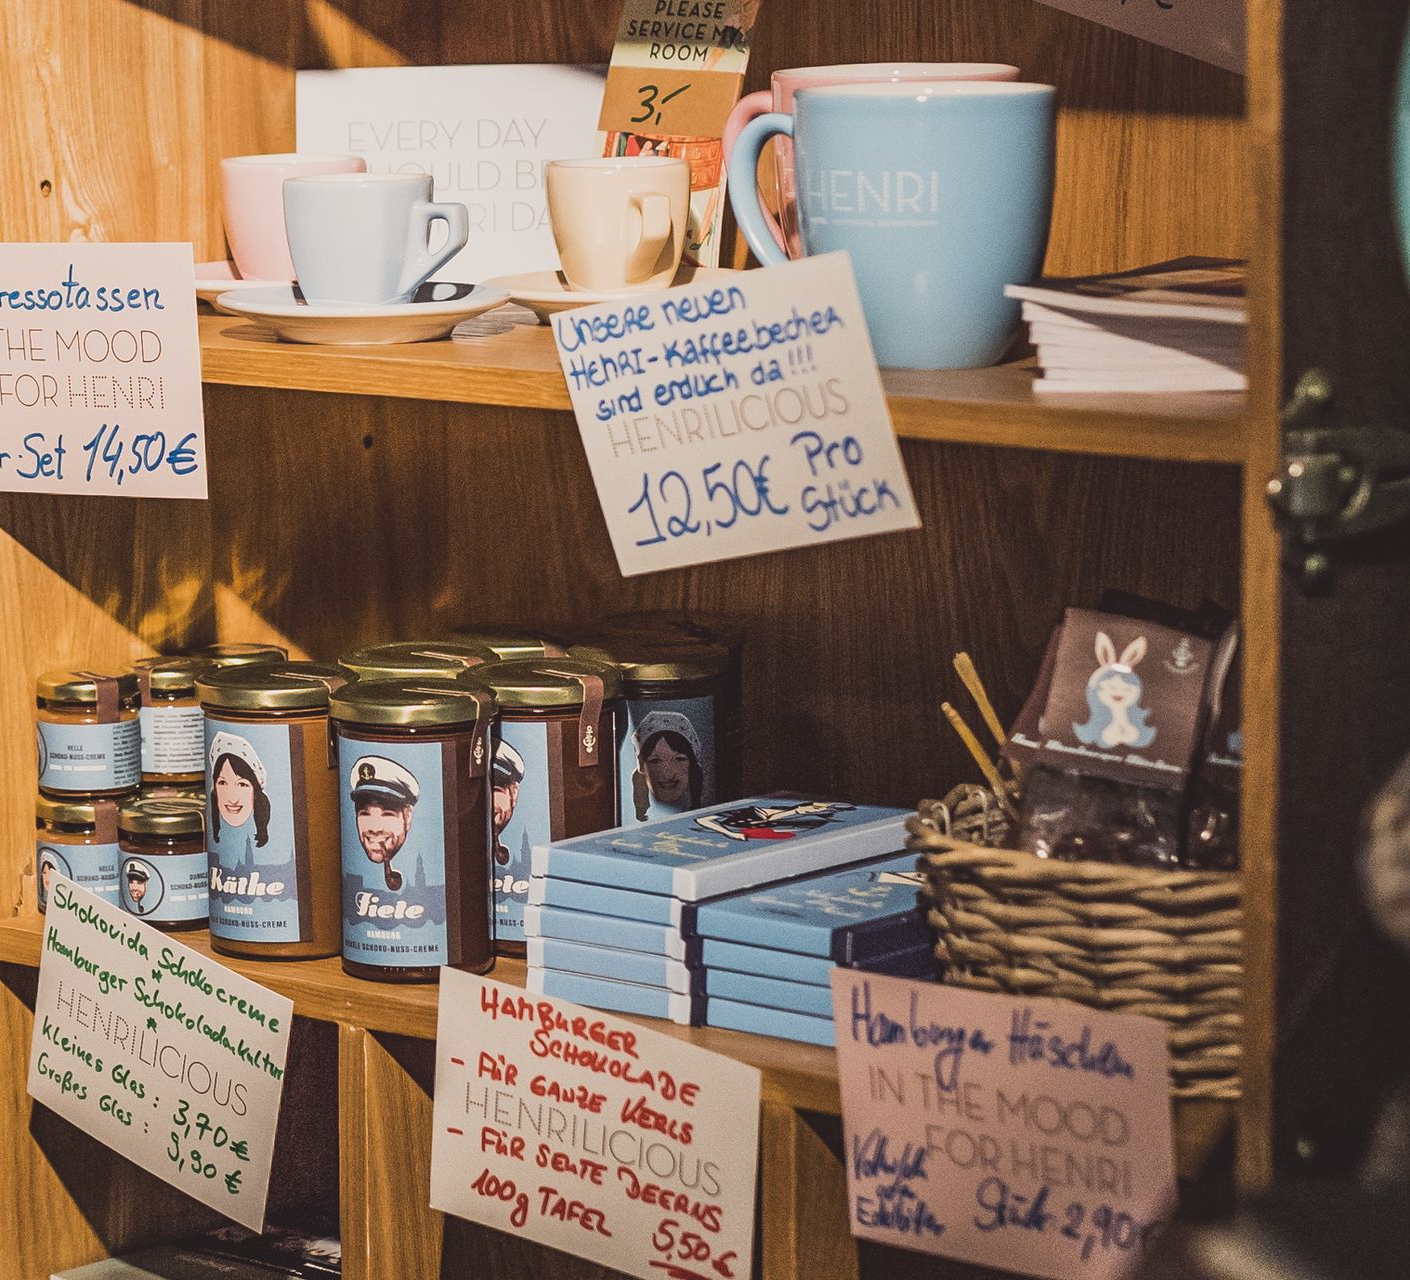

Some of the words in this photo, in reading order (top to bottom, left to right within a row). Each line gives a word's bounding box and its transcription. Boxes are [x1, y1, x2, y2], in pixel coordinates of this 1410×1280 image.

[627, 19, 706, 40] SERVICE
[655, 0, 726, 19] PLEASE
[649, 42, 709, 62] ROOM
[348, 120, 461, 152] EVERY
[477, 118, 548, 149] DAY
[806, 170, 941, 215] HENRI
[662, 286, 746, 327] neuen
[54, 329, 162, 364] MOOD
[67, 375, 166, 410] HENRI
[596, 388, 642, 421] sind
[605, 378, 851, 458] HENRILICIOUS
[209, 866, 285, 898] Käthe
[46, 926, 128, 995] Hamburger
[56, 980, 249, 1117] HENRILICIOUS
[529, 1075, 607, 1114] GANZE
[620, 1096, 694, 1146] KERLS
[869, 1065, 905, 1106] IN
[914, 1072, 986, 1122] THE
[996, 1089, 1130, 1147] MOOD
[465, 1081, 722, 1198] HENRILICIOUS
[924, 1122, 1004, 1172] FOR
[1011, 1138, 1133, 1197] HENRI
[538, 1185, 613, 1238] TAFEL
